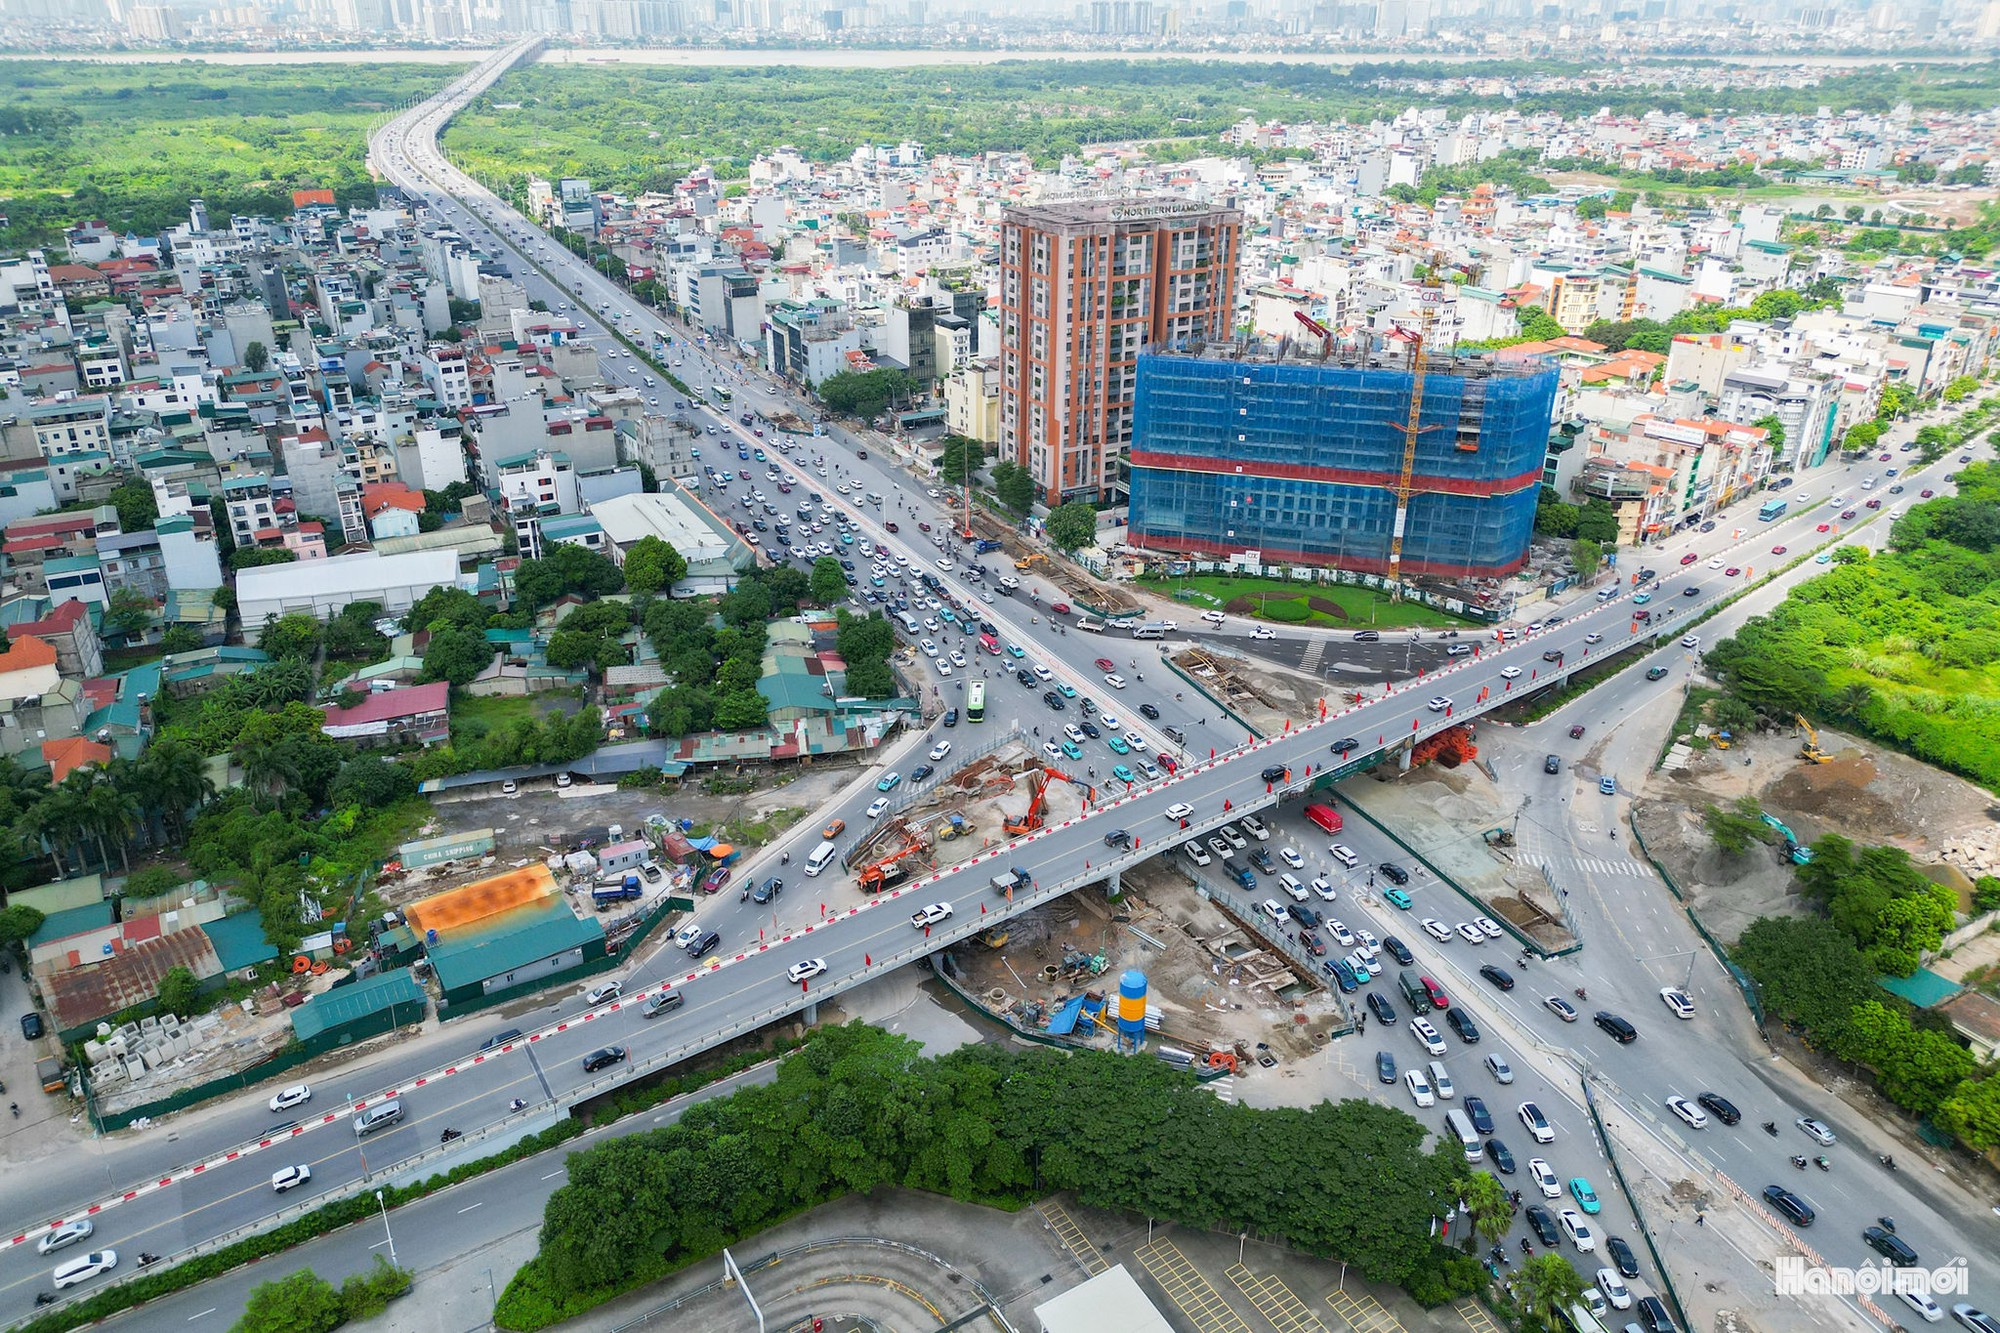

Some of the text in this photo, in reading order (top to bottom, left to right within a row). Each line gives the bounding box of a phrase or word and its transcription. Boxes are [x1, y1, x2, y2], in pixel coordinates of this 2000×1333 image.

[1124, 203, 1210, 217] NORTHERN DIAMOND
[423, 845, 474, 860] CHINA SHIPPING
